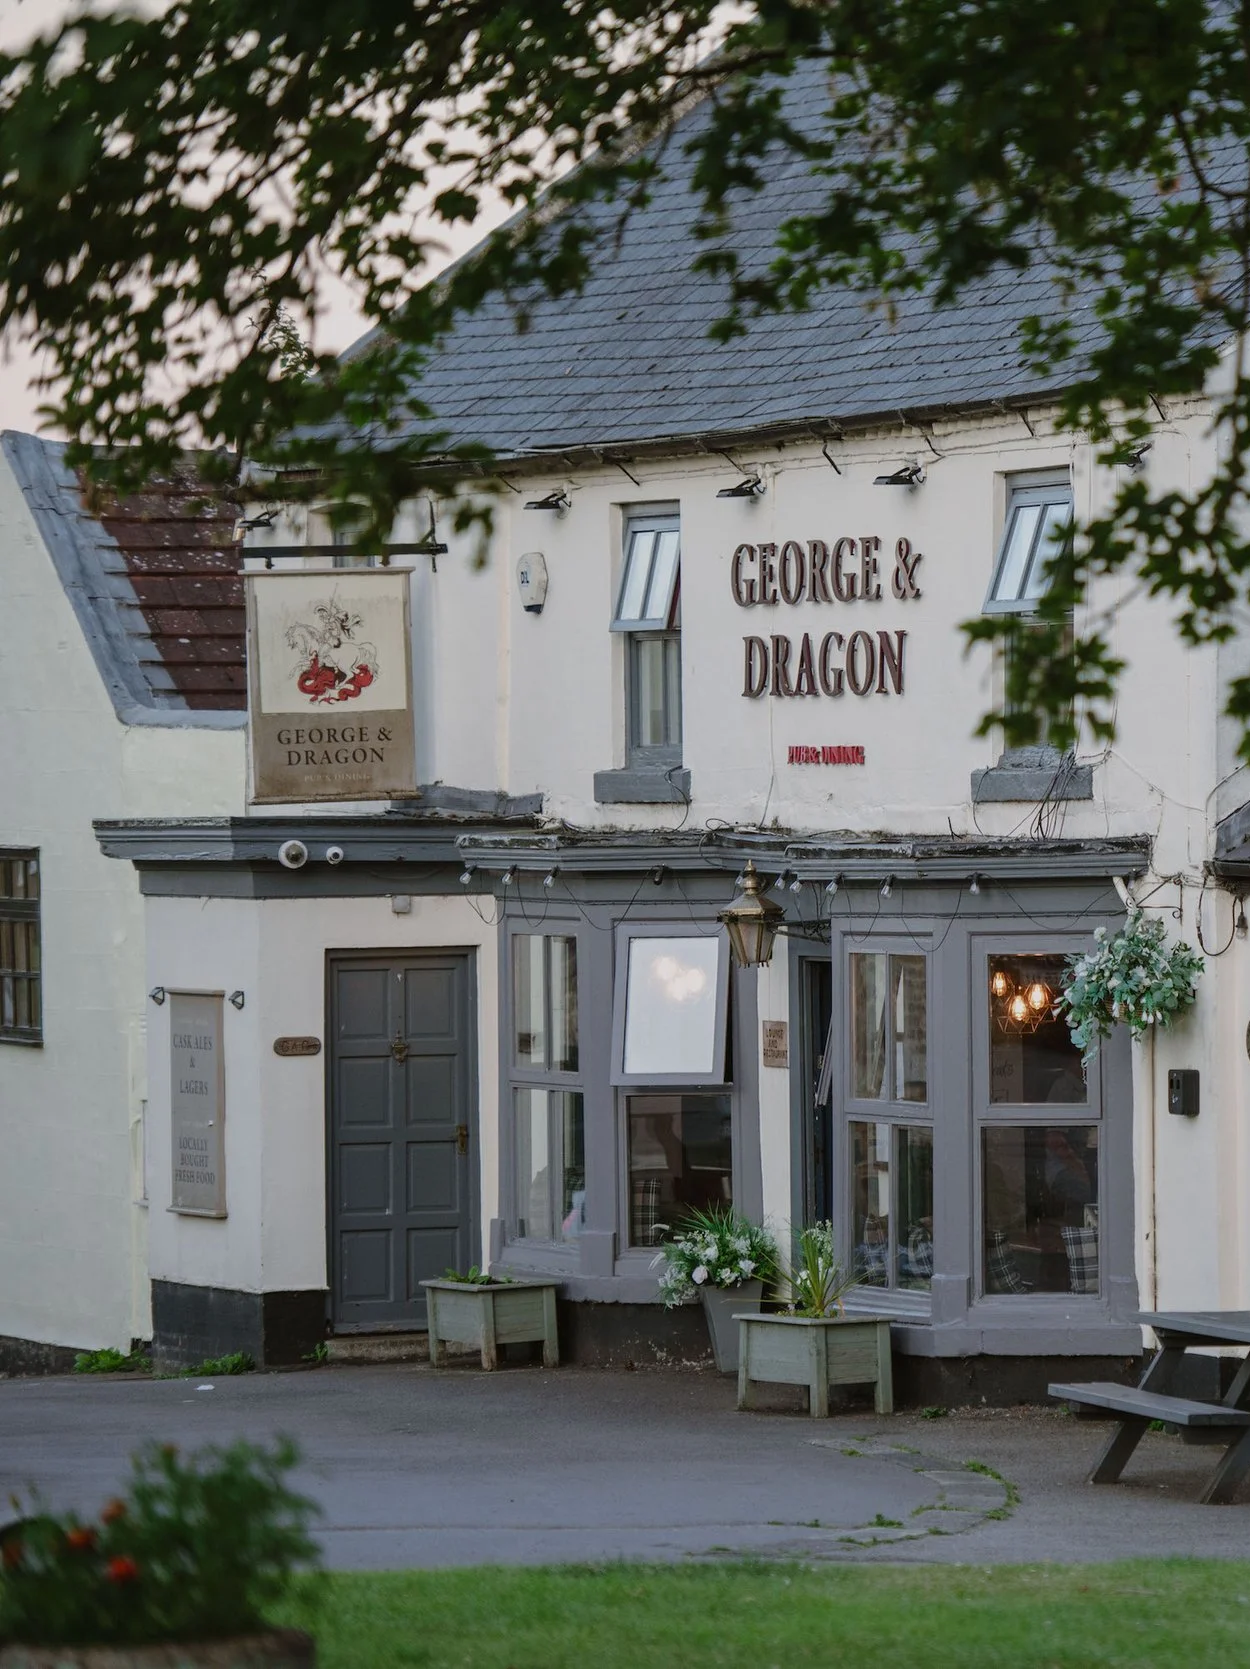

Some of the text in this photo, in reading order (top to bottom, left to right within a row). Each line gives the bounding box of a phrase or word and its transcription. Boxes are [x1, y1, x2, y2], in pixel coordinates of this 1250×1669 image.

[731, 536, 921, 607] GEORGE &
[742, 630, 907, 698] DRAGON
[277, 727, 393, 745] GEORGE &
[287, 748, 385, 766] DRAGON
[173, 1034, 213, 1051] CASK ALES
[180, 1080, 209, 1096] LAGERS
[179, 1136, 208, 1152] LOCALLY
[180, 1153, 209, 1168] BOUGHT
[174, 1169, 215, 1185] FRESH FOOD
